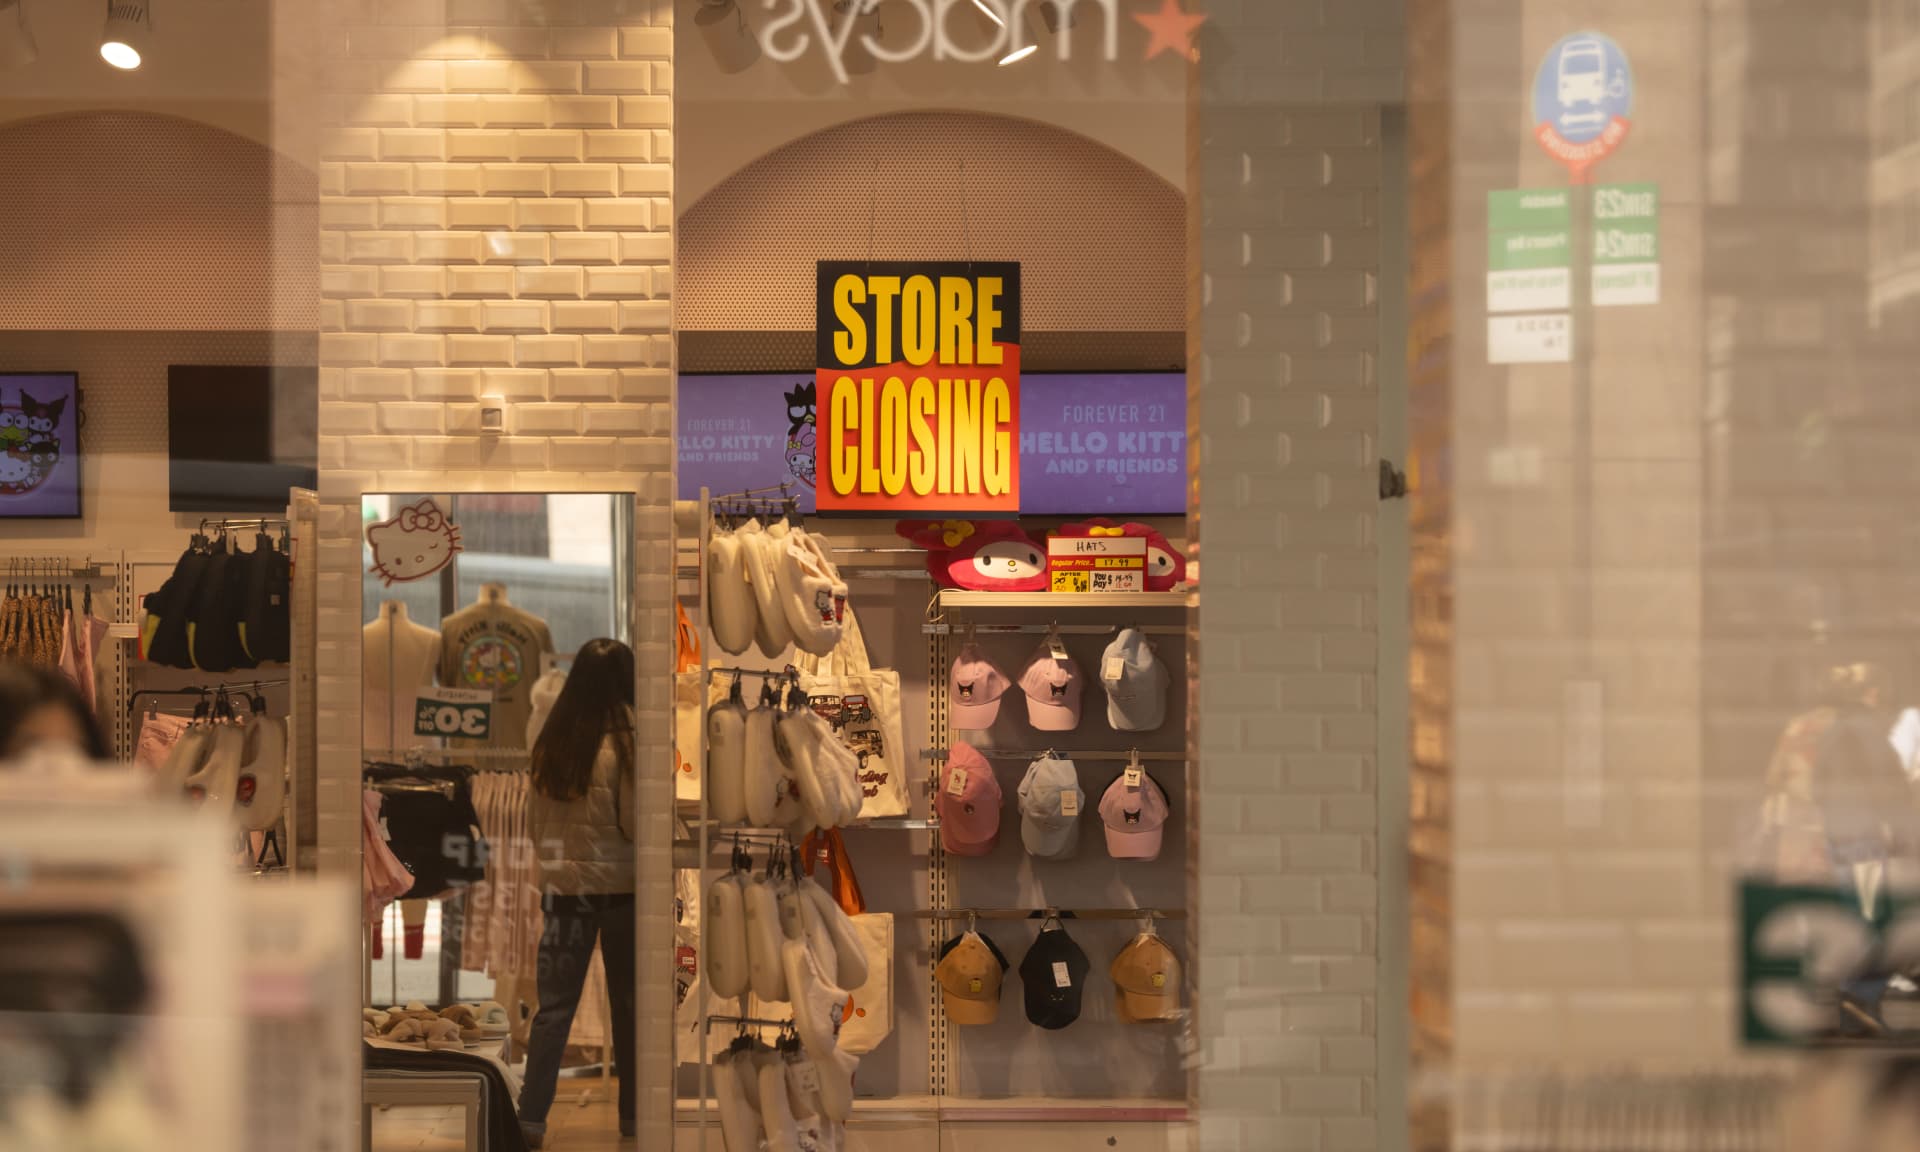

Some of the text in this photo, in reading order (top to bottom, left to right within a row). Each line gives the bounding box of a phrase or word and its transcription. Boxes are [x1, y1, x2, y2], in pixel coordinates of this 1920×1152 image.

[833, 274, 1004, 366] STORE
[1063, 404, 1166, 424] FOREVER 21
[687, 417, 752, 433] FOREVER 21
[720, 434, 774, 449] KITTY
[830, 376, 1011, 496] CLOSING
[1020, 431, 1185, 454] HELLO KITT
[679, 451, 760, 463] AND FRIENDS
[1045, 458, 1178, 474] AND FRIENDS
[1076, 541, 1107, 552] HATS
